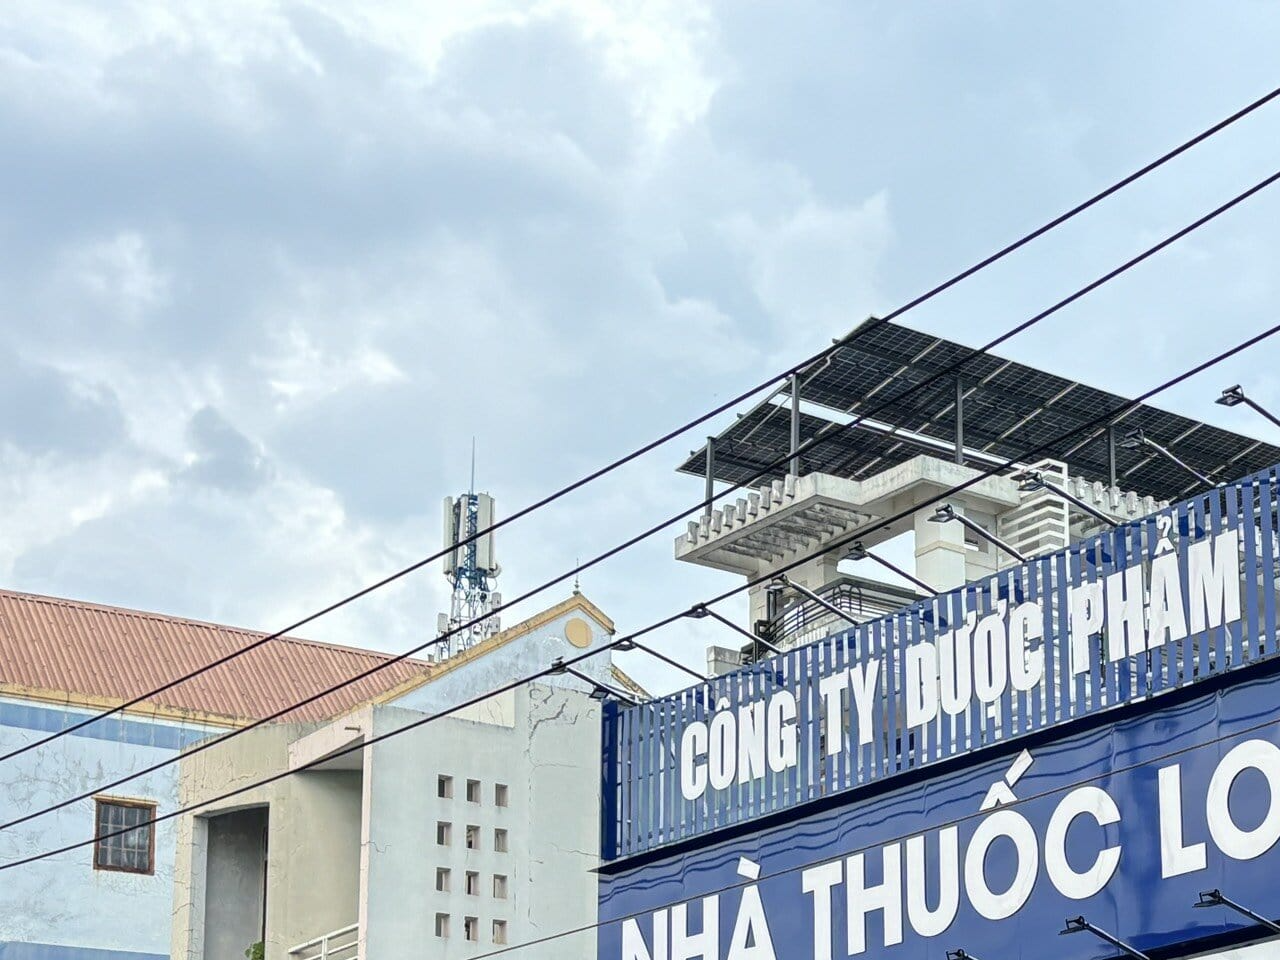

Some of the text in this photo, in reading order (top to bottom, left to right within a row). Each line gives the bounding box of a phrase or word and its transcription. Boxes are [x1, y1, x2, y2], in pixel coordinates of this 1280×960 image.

[681, 515, 1241, 801] CÔNG TY DƯỢC PHẨM
